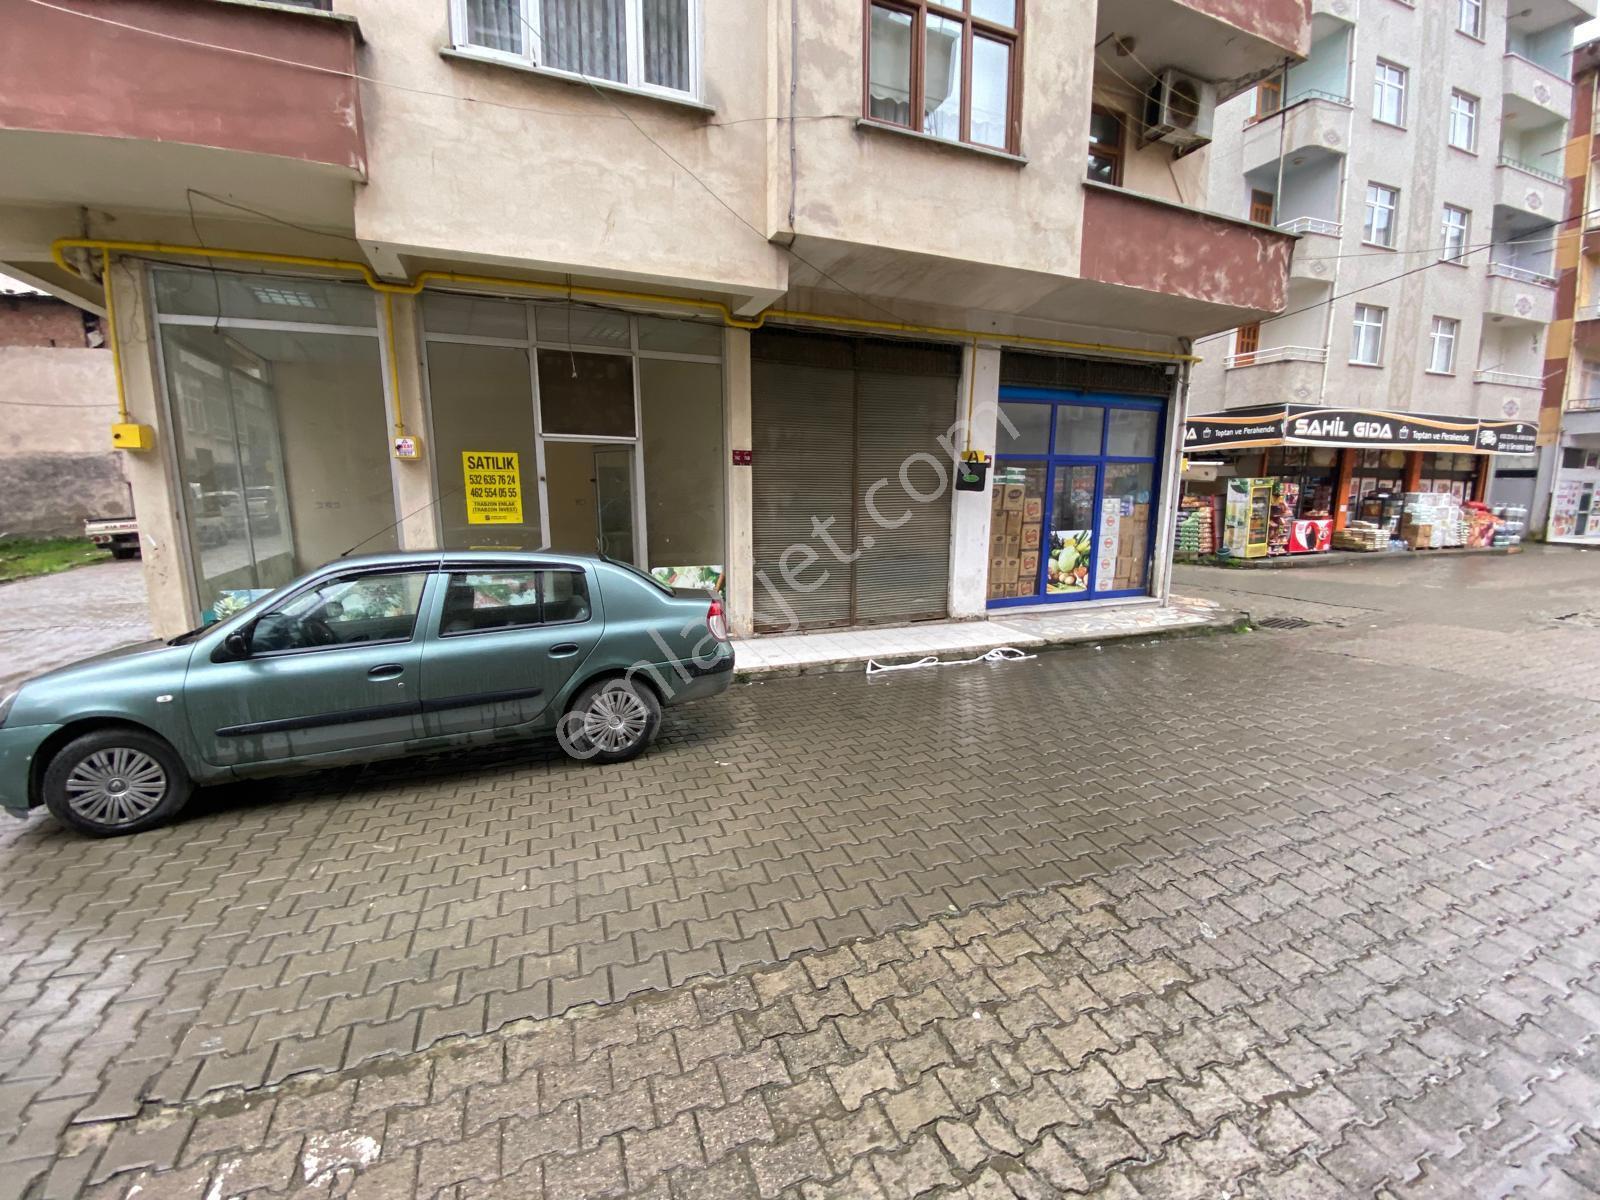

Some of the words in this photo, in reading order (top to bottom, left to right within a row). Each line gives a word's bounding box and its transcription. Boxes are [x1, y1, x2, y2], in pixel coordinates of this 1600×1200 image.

[1215, 429, 1233, 438] Toptan
[1294, 416, 1349, 437] SAHİL
[1353, 421, 1393, 439] GIDA
[467, 456, 514, 469] SATILIK
[469, 474, 482, 485] 532
[507, 474, 516, 485] 24
